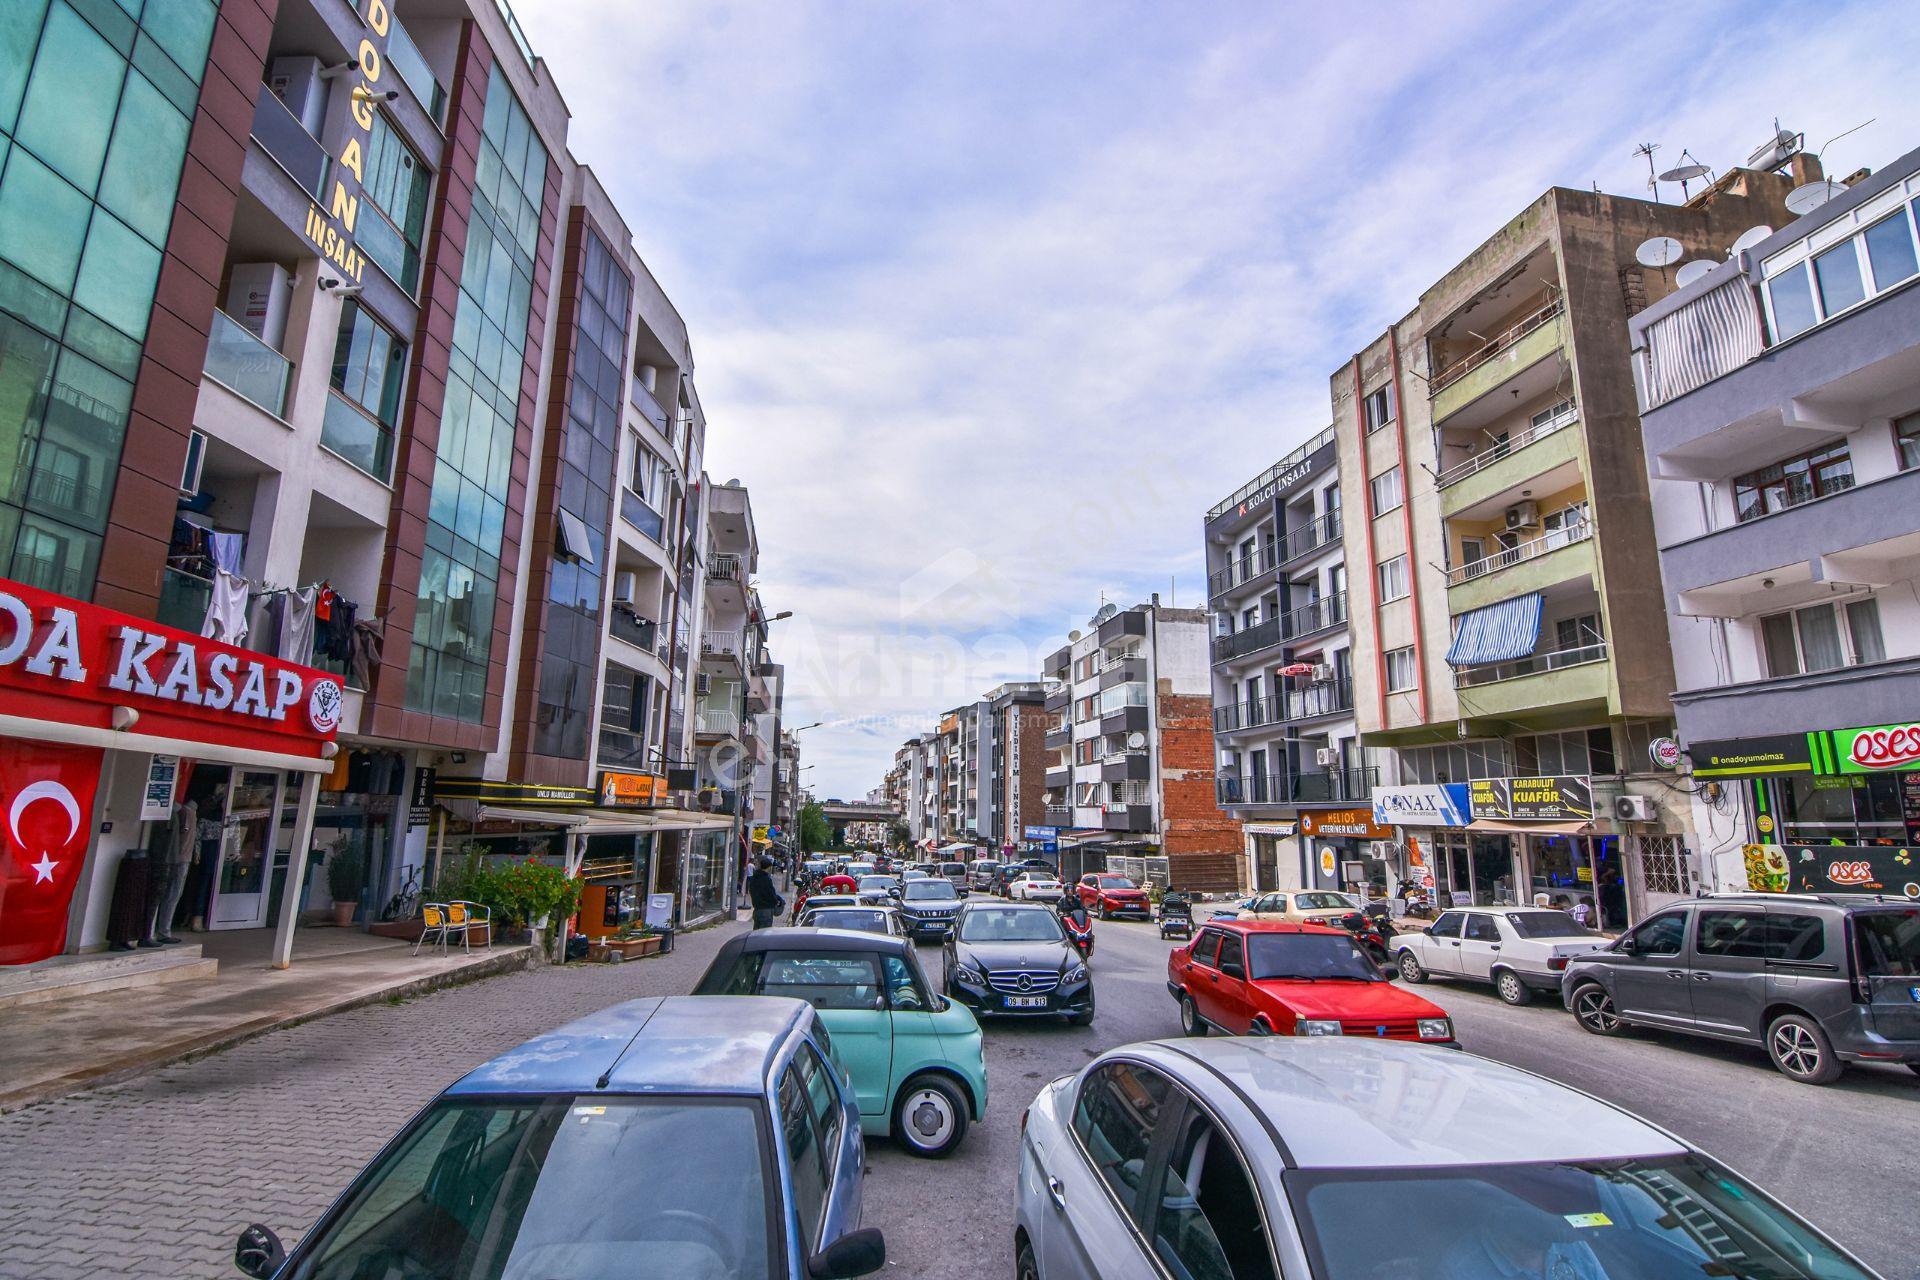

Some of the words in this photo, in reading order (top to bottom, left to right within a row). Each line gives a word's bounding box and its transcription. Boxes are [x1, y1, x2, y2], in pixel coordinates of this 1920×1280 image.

[305, 202, 366, 284] İNŞAAT
[1248, 485, 1276, 511] KOLCU
[1277, 460, 1312, 492] İNŞAAT
[109, 626, 303, 721] KASAP
[1012, 714, 1020, 776] YILDIRIM
[1720, 753, 1784, 764] onadoyumolmaz
[1513, 779, 1555, 789] KARABULUT
[1382, 795, 1437, 812] CONAX
[1513, 788, 1559, 803] KUAFÖR
[1009, 997, 1017, 1006] 09
[1034, 997, 1046, 1006] 613
